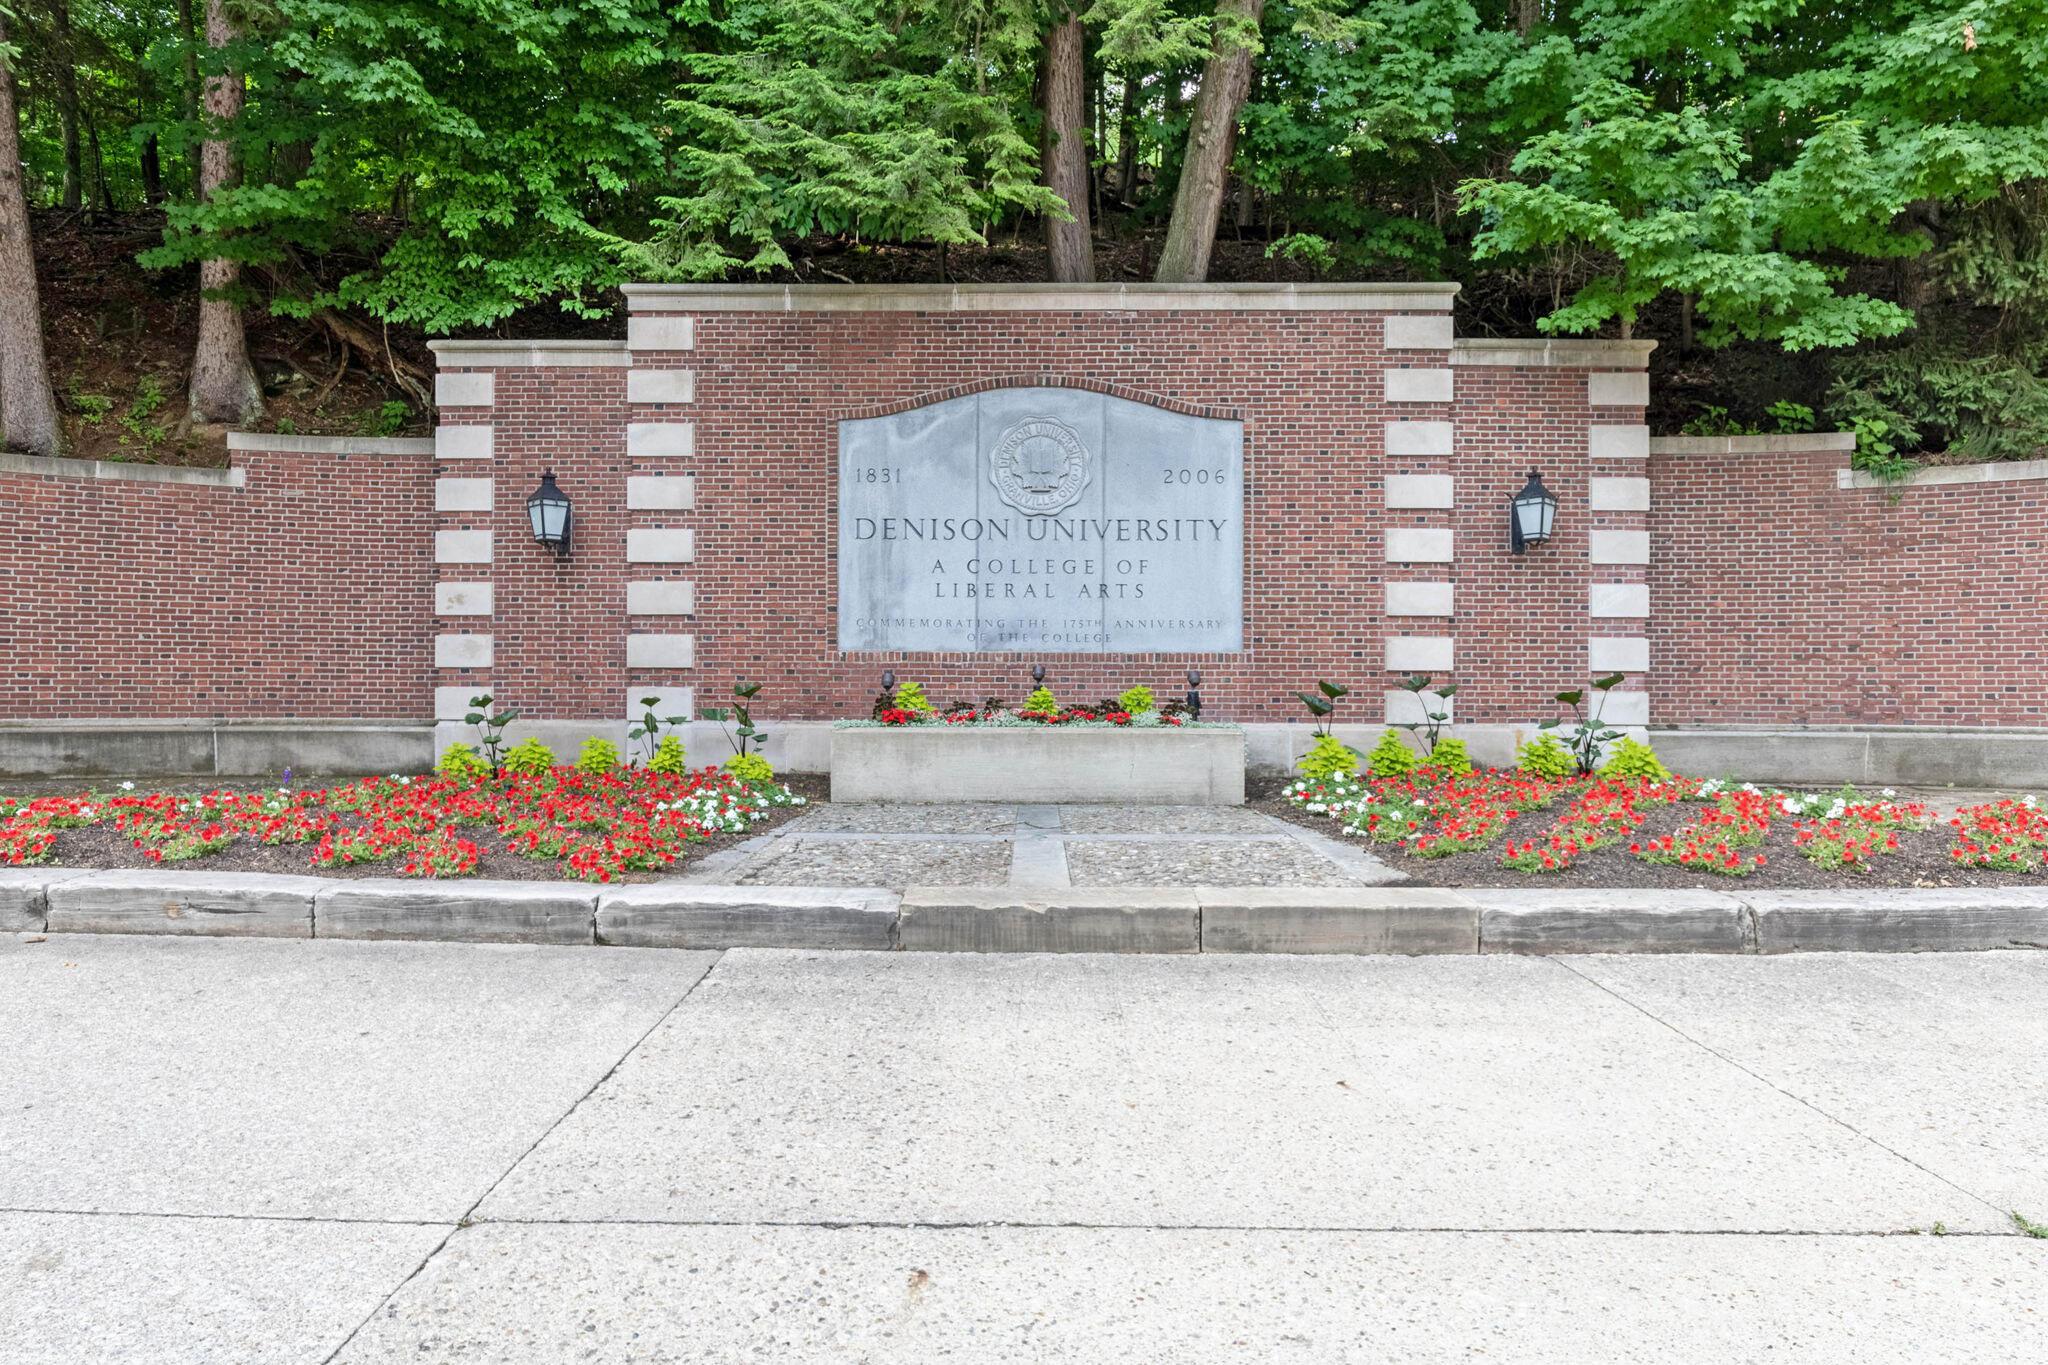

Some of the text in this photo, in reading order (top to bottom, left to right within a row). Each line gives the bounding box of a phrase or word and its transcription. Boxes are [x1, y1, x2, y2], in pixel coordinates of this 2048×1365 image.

[998, 426, 1033, 469] DENISON
[856, 468, 901, 483] 1831
[1163, 469, 1226, 485] 2006
[1059, 473, 1079, 498] OHIO
[855, 517, 1228, 542] DENISON UNIVERSITY
[931, 559, 1149, 575] A COLLEGE OF
[935, 583, 1144, 599] LIBERAL ARTS
[856, 618, 1223, 630] COMMEMORATING THE 175TH ANNIVERSARY
[967, 633, 1112, 643] OF THE COLLEGE
